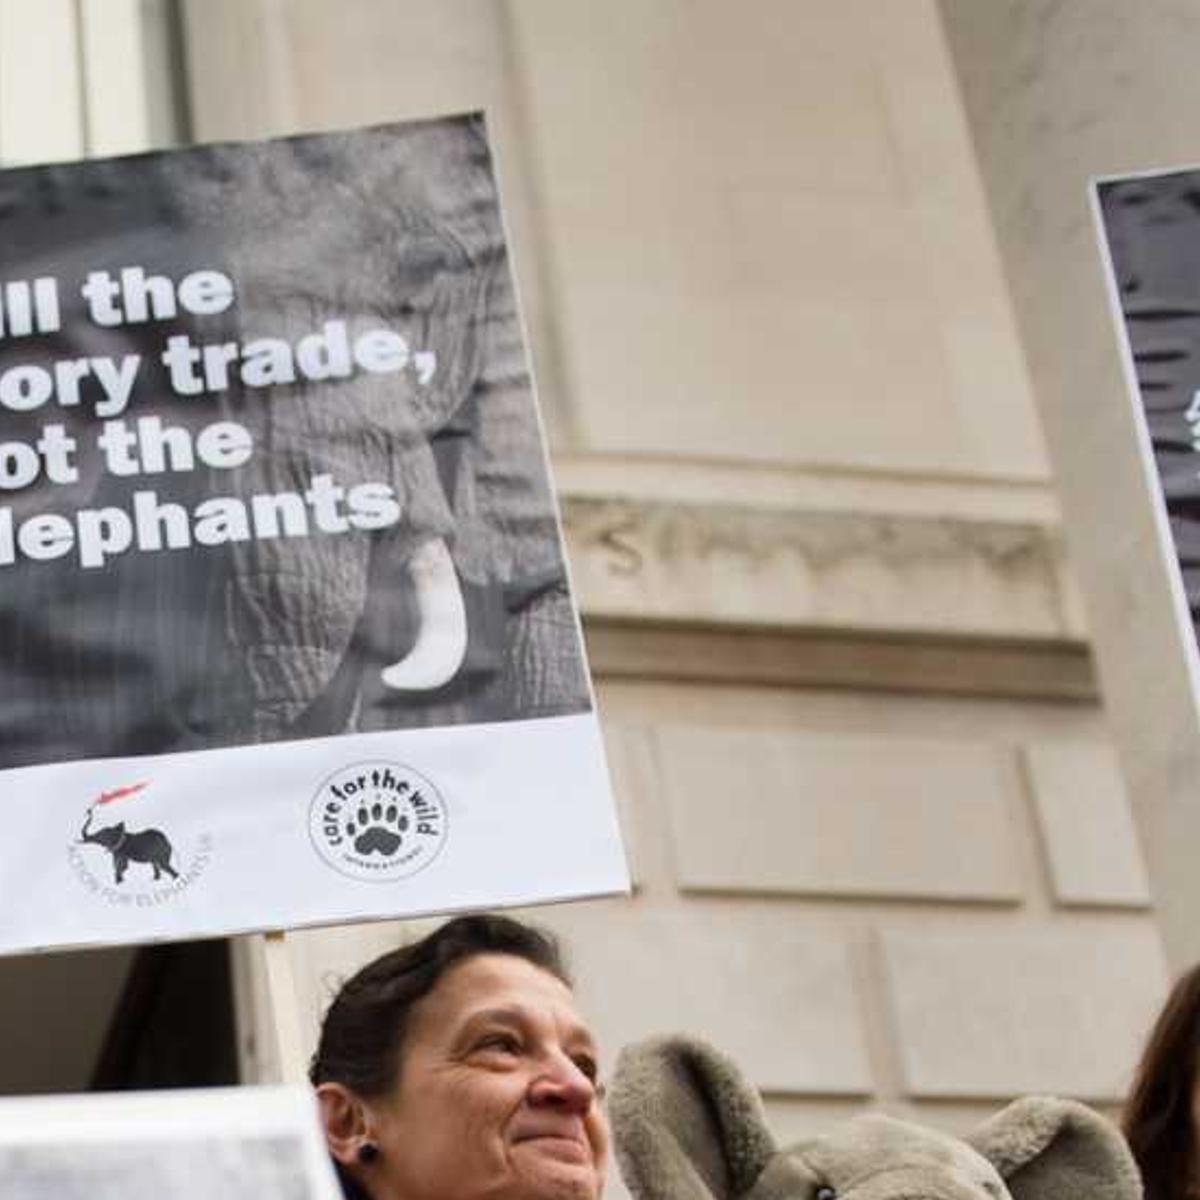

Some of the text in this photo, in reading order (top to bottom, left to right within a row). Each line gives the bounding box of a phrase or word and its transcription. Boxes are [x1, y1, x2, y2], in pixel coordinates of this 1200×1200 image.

[82, 265, 233, 327] the
[163, 320, 436, 397] trade,
[98, 414, 253, 477] the
[324, 802, 343, 846] care
[372, 768, 410, 795] the
[409, 790, 439, 836] wild
